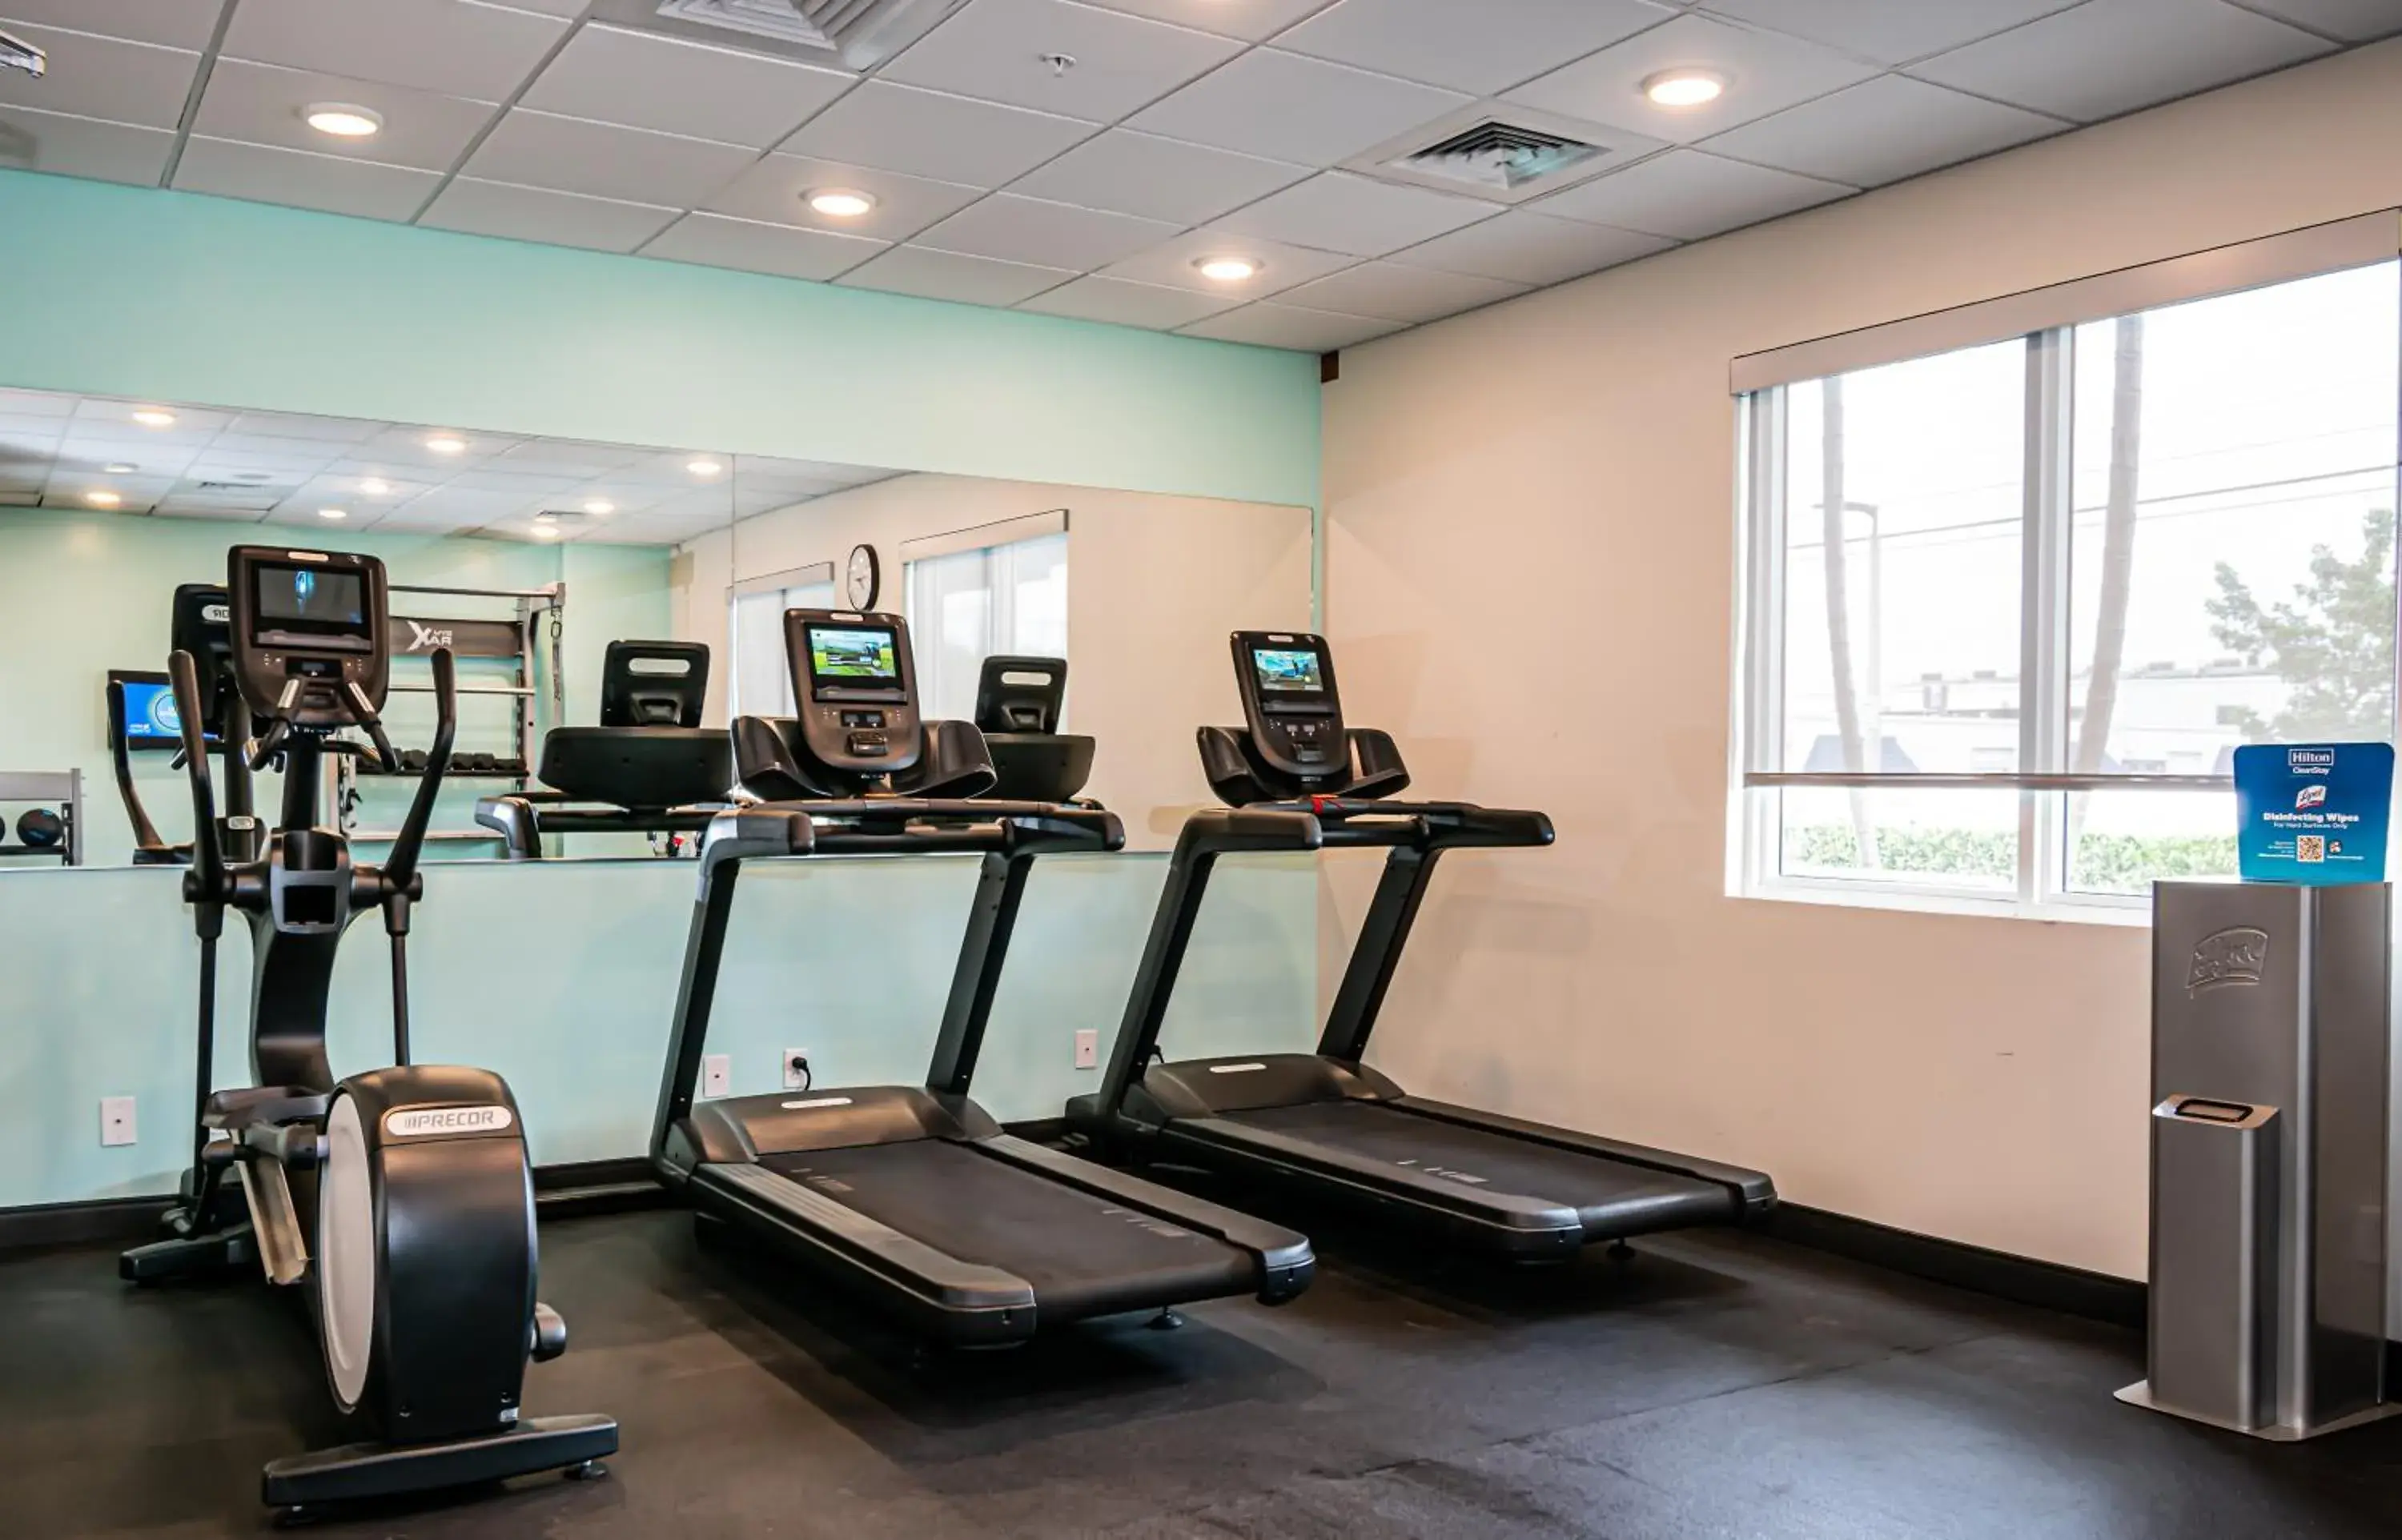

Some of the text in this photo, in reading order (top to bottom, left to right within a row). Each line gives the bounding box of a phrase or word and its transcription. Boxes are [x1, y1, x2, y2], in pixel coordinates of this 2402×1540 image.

[2292, 752, 2331, 763] Hilton
[2263, 812, 2360, 823] Disinfecting Wipes
[416, 1110, 494, 1129] PRECOR
